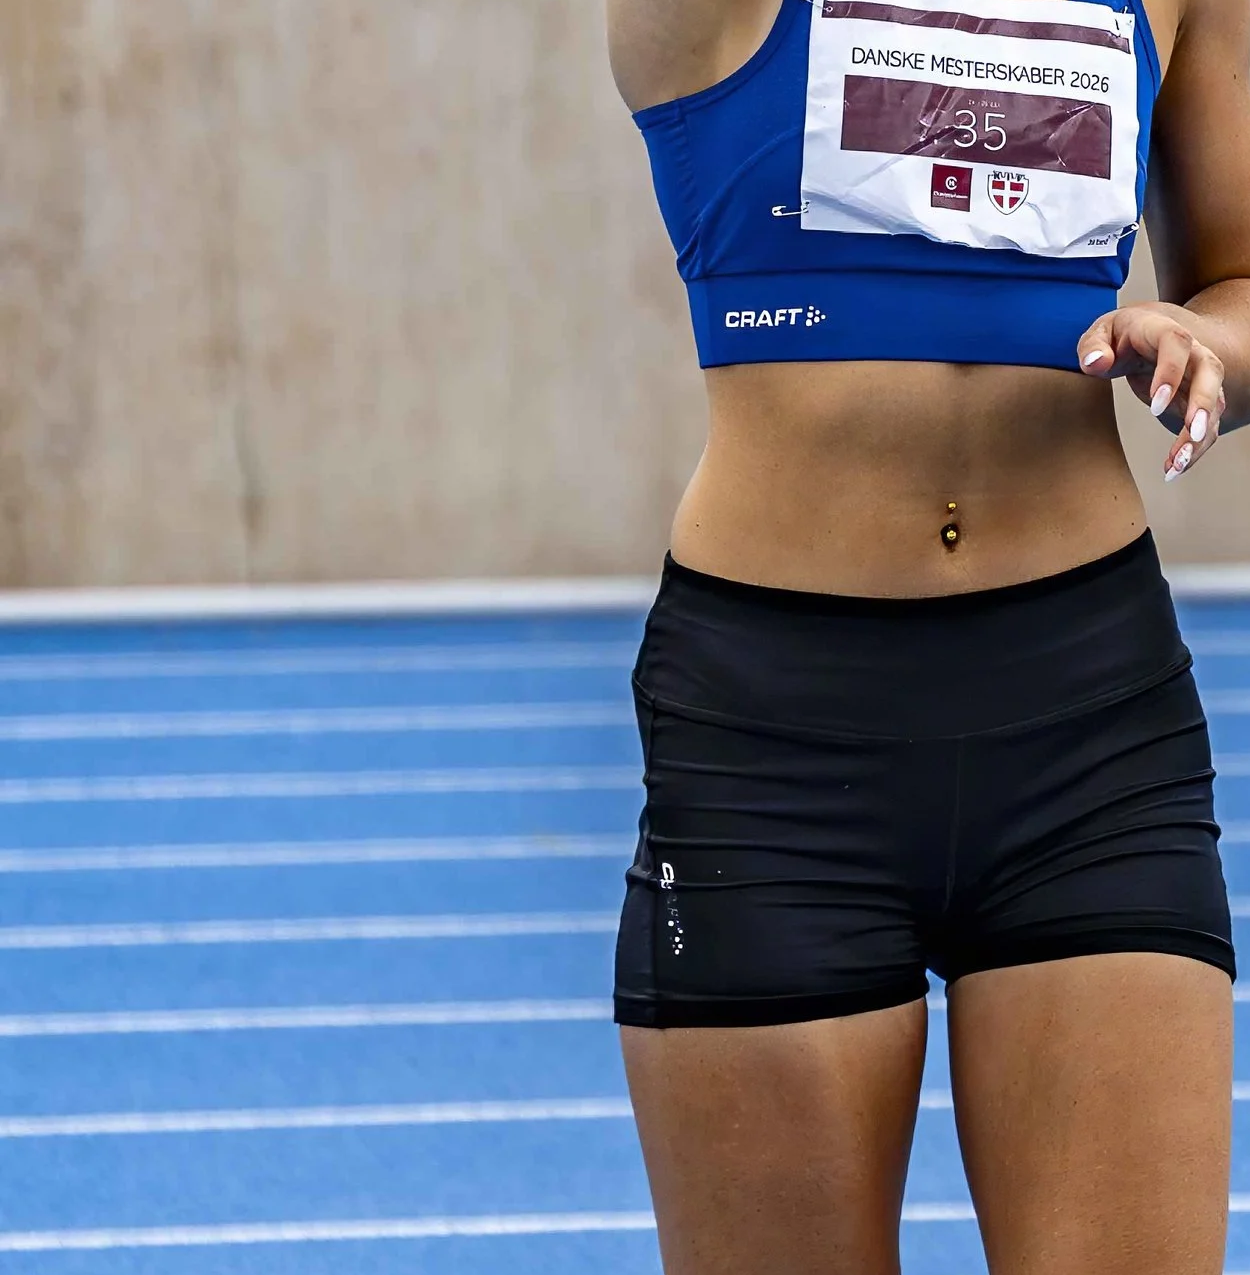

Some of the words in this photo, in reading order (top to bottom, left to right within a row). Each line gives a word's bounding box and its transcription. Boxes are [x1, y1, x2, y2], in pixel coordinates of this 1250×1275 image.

[852, 47, 925, 70] DANSKE
[931, 54, 1065, 86] MESTERSKABER
[1070, 71, 1110, 93] 2026
[953, 109, 1006, 151] 35
[725, 308, 803, 327] CRAFT
